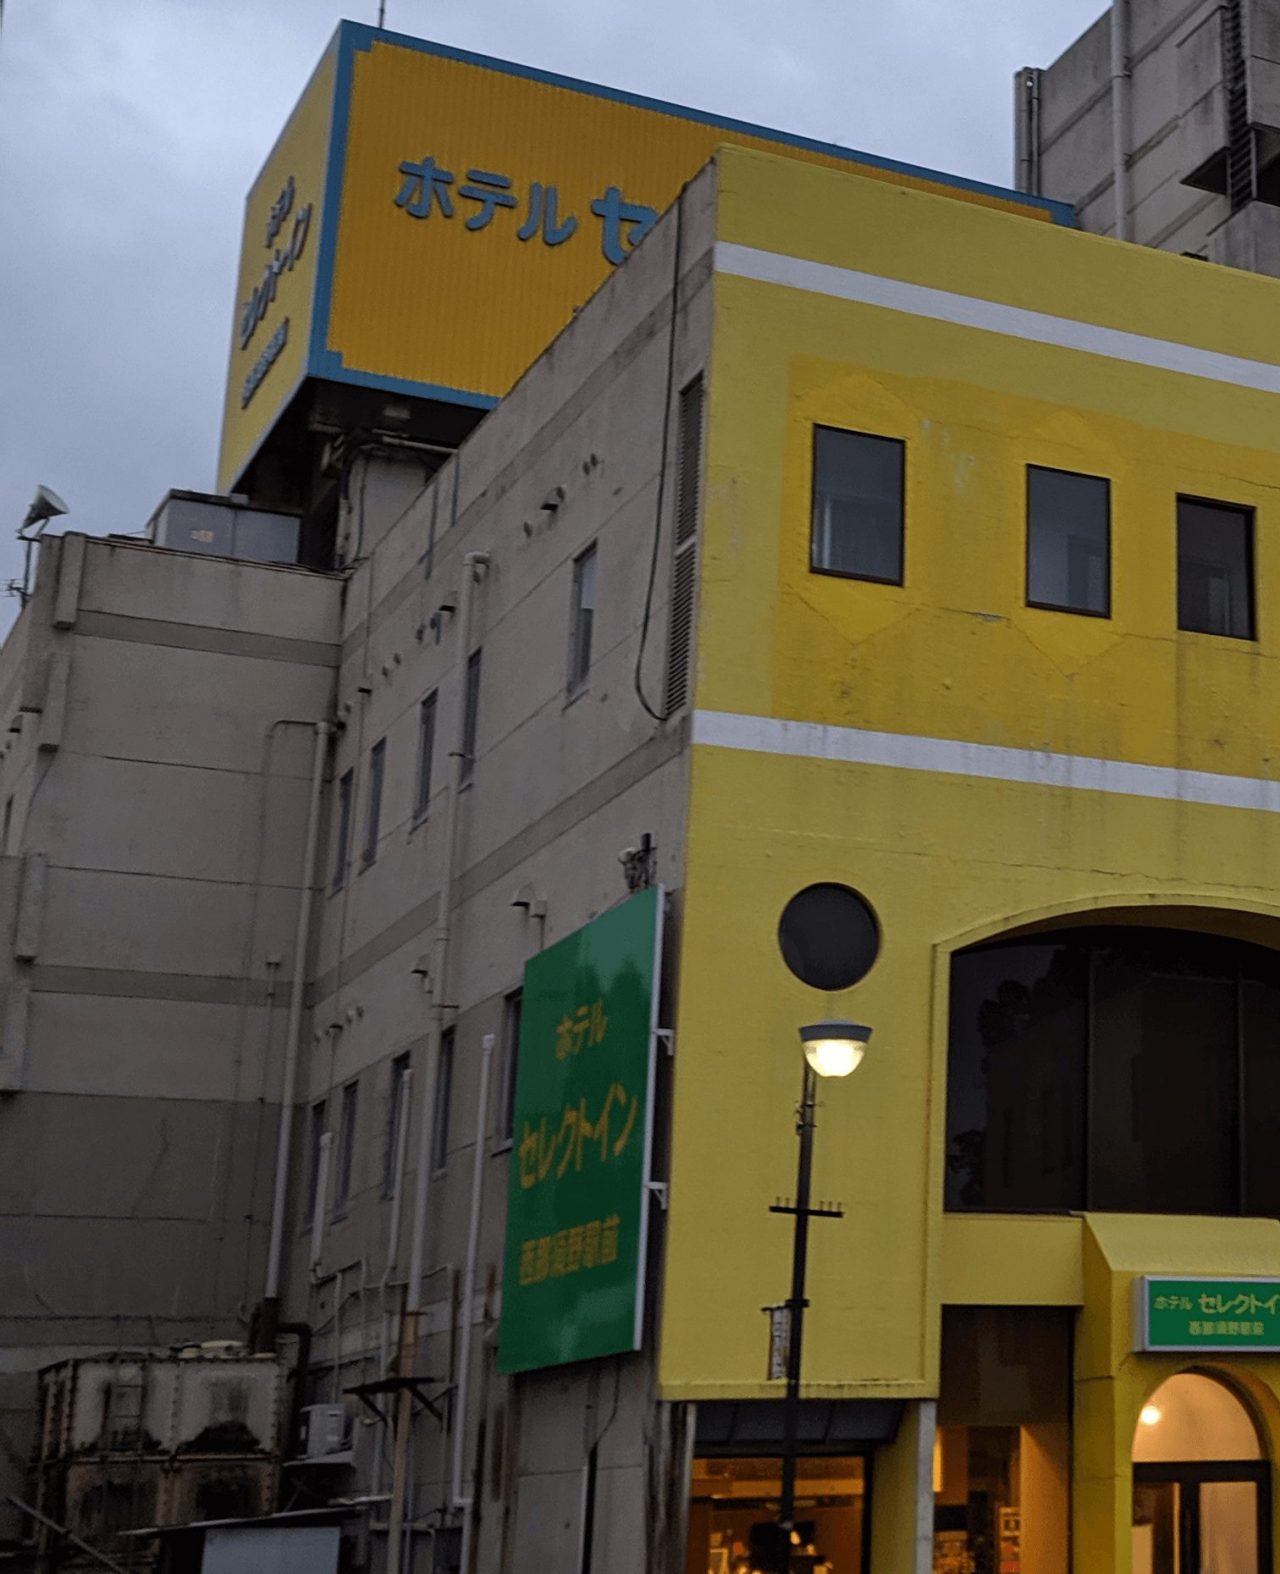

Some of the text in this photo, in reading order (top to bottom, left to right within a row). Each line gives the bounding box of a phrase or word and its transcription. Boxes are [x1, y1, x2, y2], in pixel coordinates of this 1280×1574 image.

[395, 156, 578, 246] ホテル
[555, 1001, 608, 1061] ホテル
[519, 1082, 638, 1189] セレクトイン
[1153, 1295, 1194, 1311] ホテル
